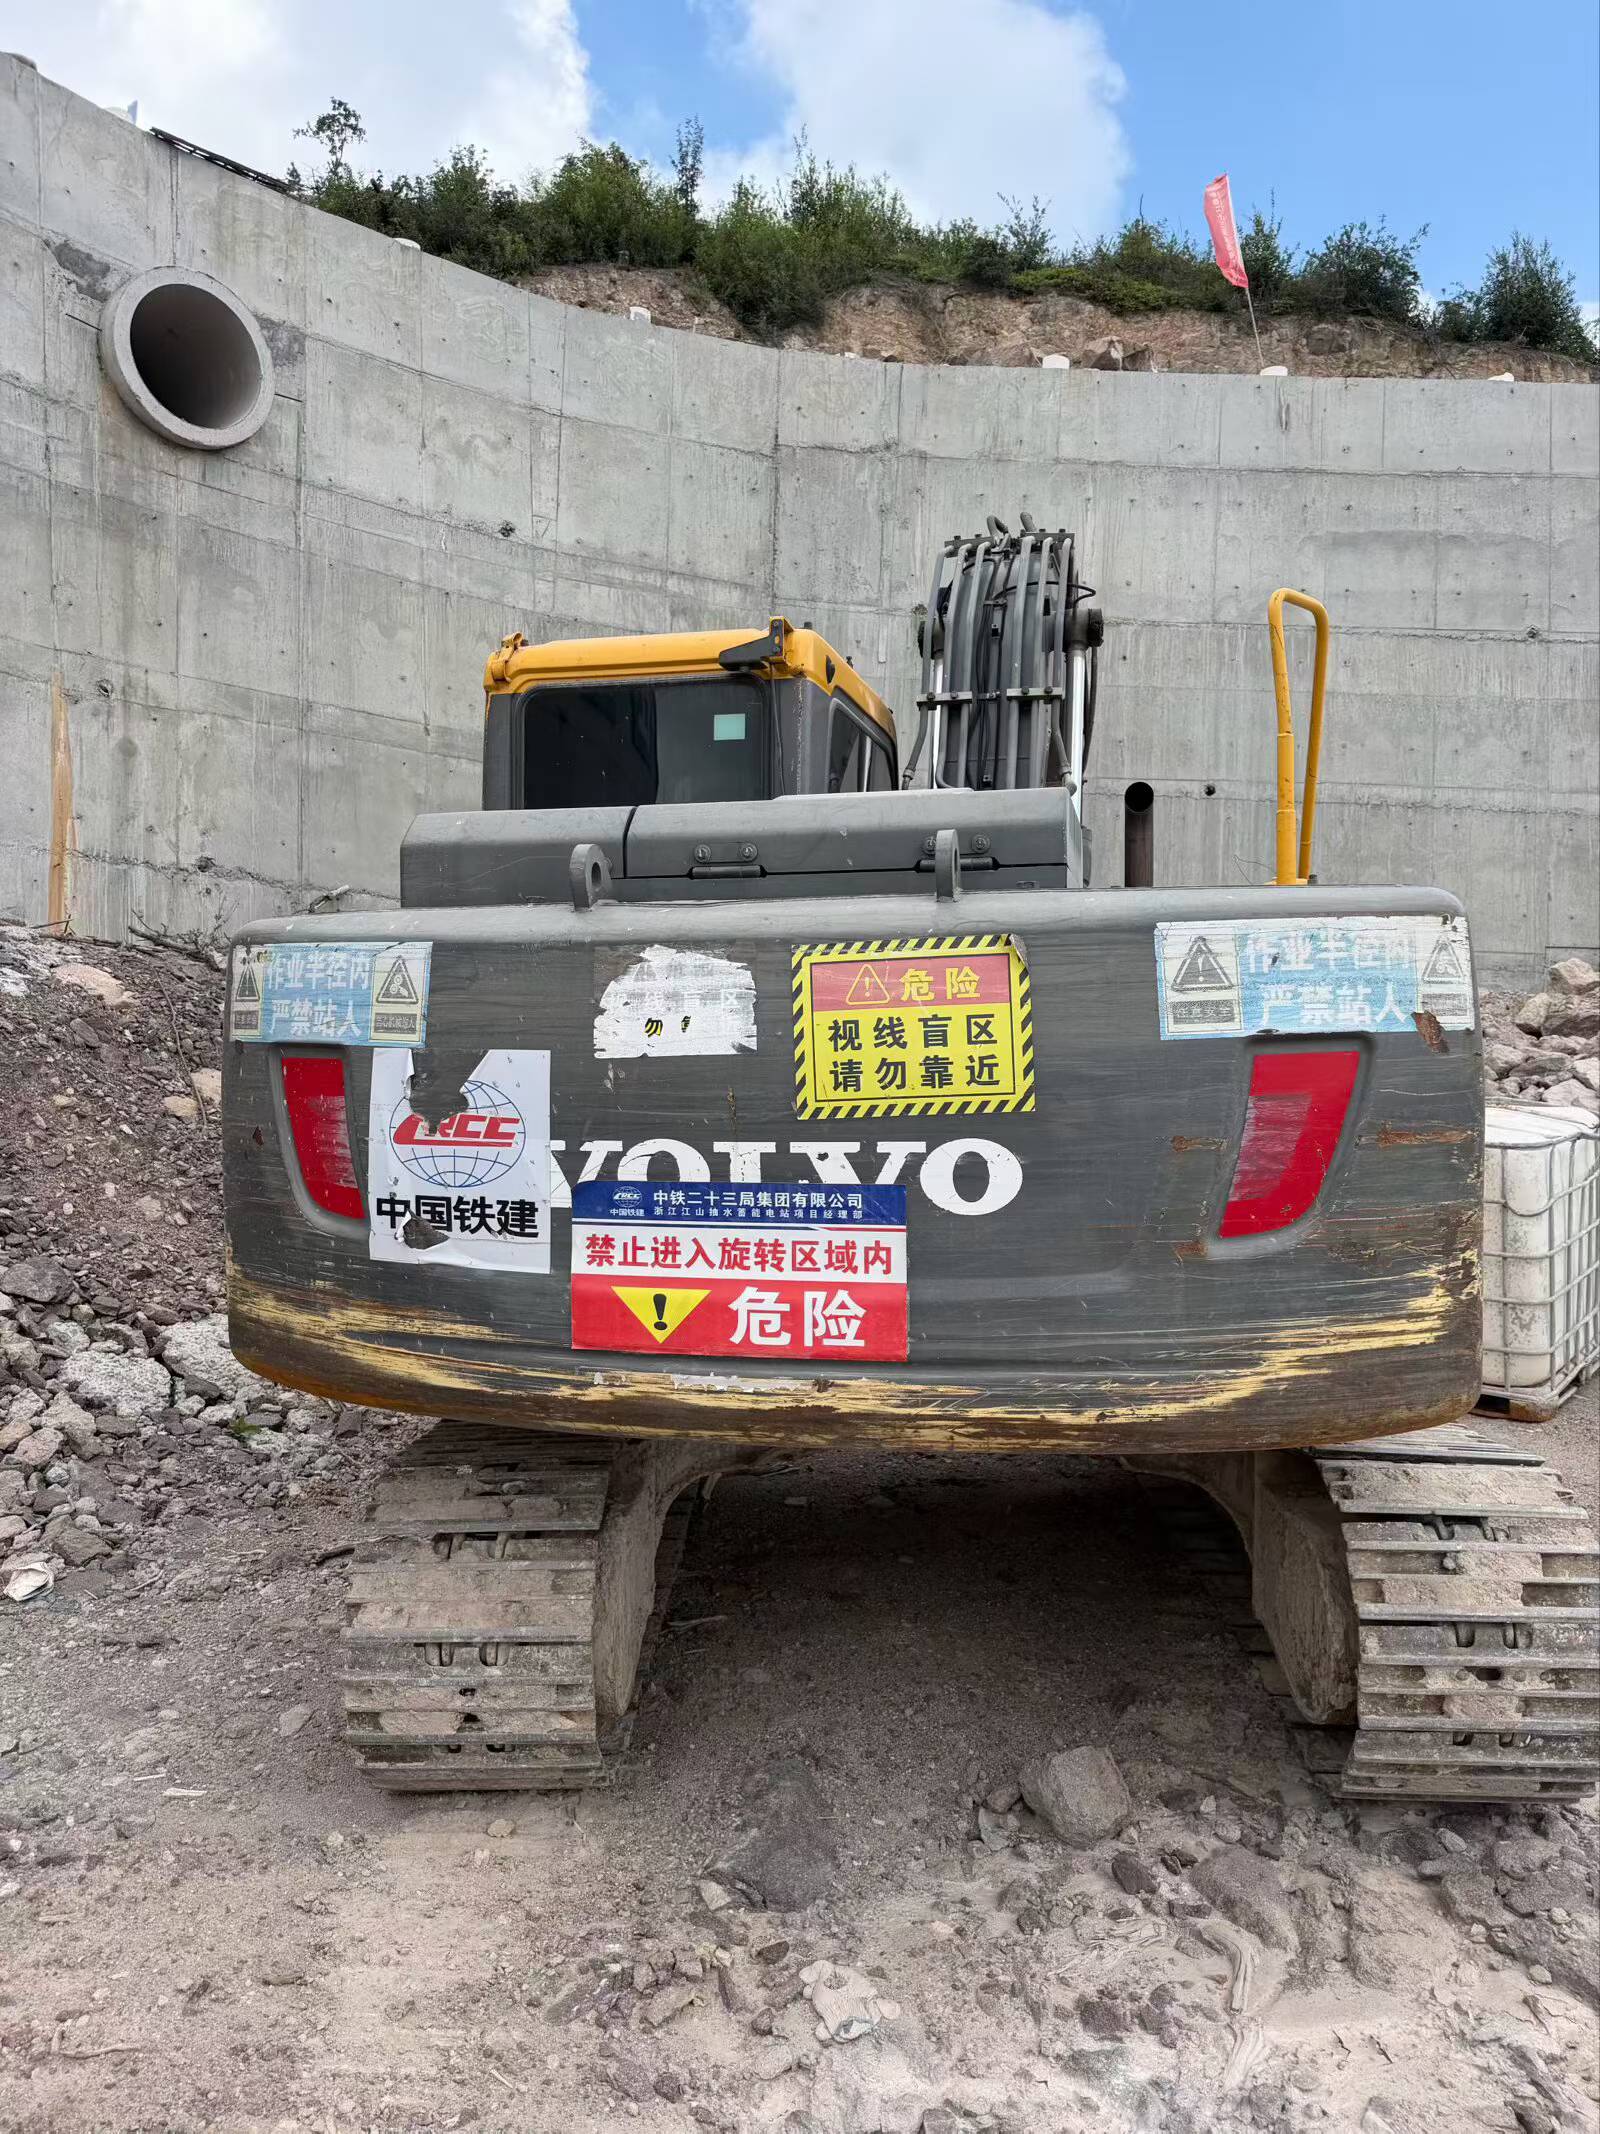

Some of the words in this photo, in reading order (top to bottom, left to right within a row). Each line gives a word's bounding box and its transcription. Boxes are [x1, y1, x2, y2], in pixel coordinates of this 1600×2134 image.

[900, 966, 980, 1001] 危险
[270, 999, 361, 1036] 严禁站人
[1260, 983, 1407, 1027] 严禁站人
[828, 1014, 998, 1052] 视线盲区
[829, 1054, 1000, 1093] 请勿靠近
[376, 1194, 539, 1238] 中国铁建
[610, 1208, 645, 1217] 中国铁建
[653, 1190, 862, 1209] 中铁二十三局集团有限公司
[654, 1206, 863, 1219] 浙江江山抽水蓄能电站项目经理部
[585, 1233, 893, 1275] 禁止进入旋转区域内
[728, 1286, 867, 1347] 危险
